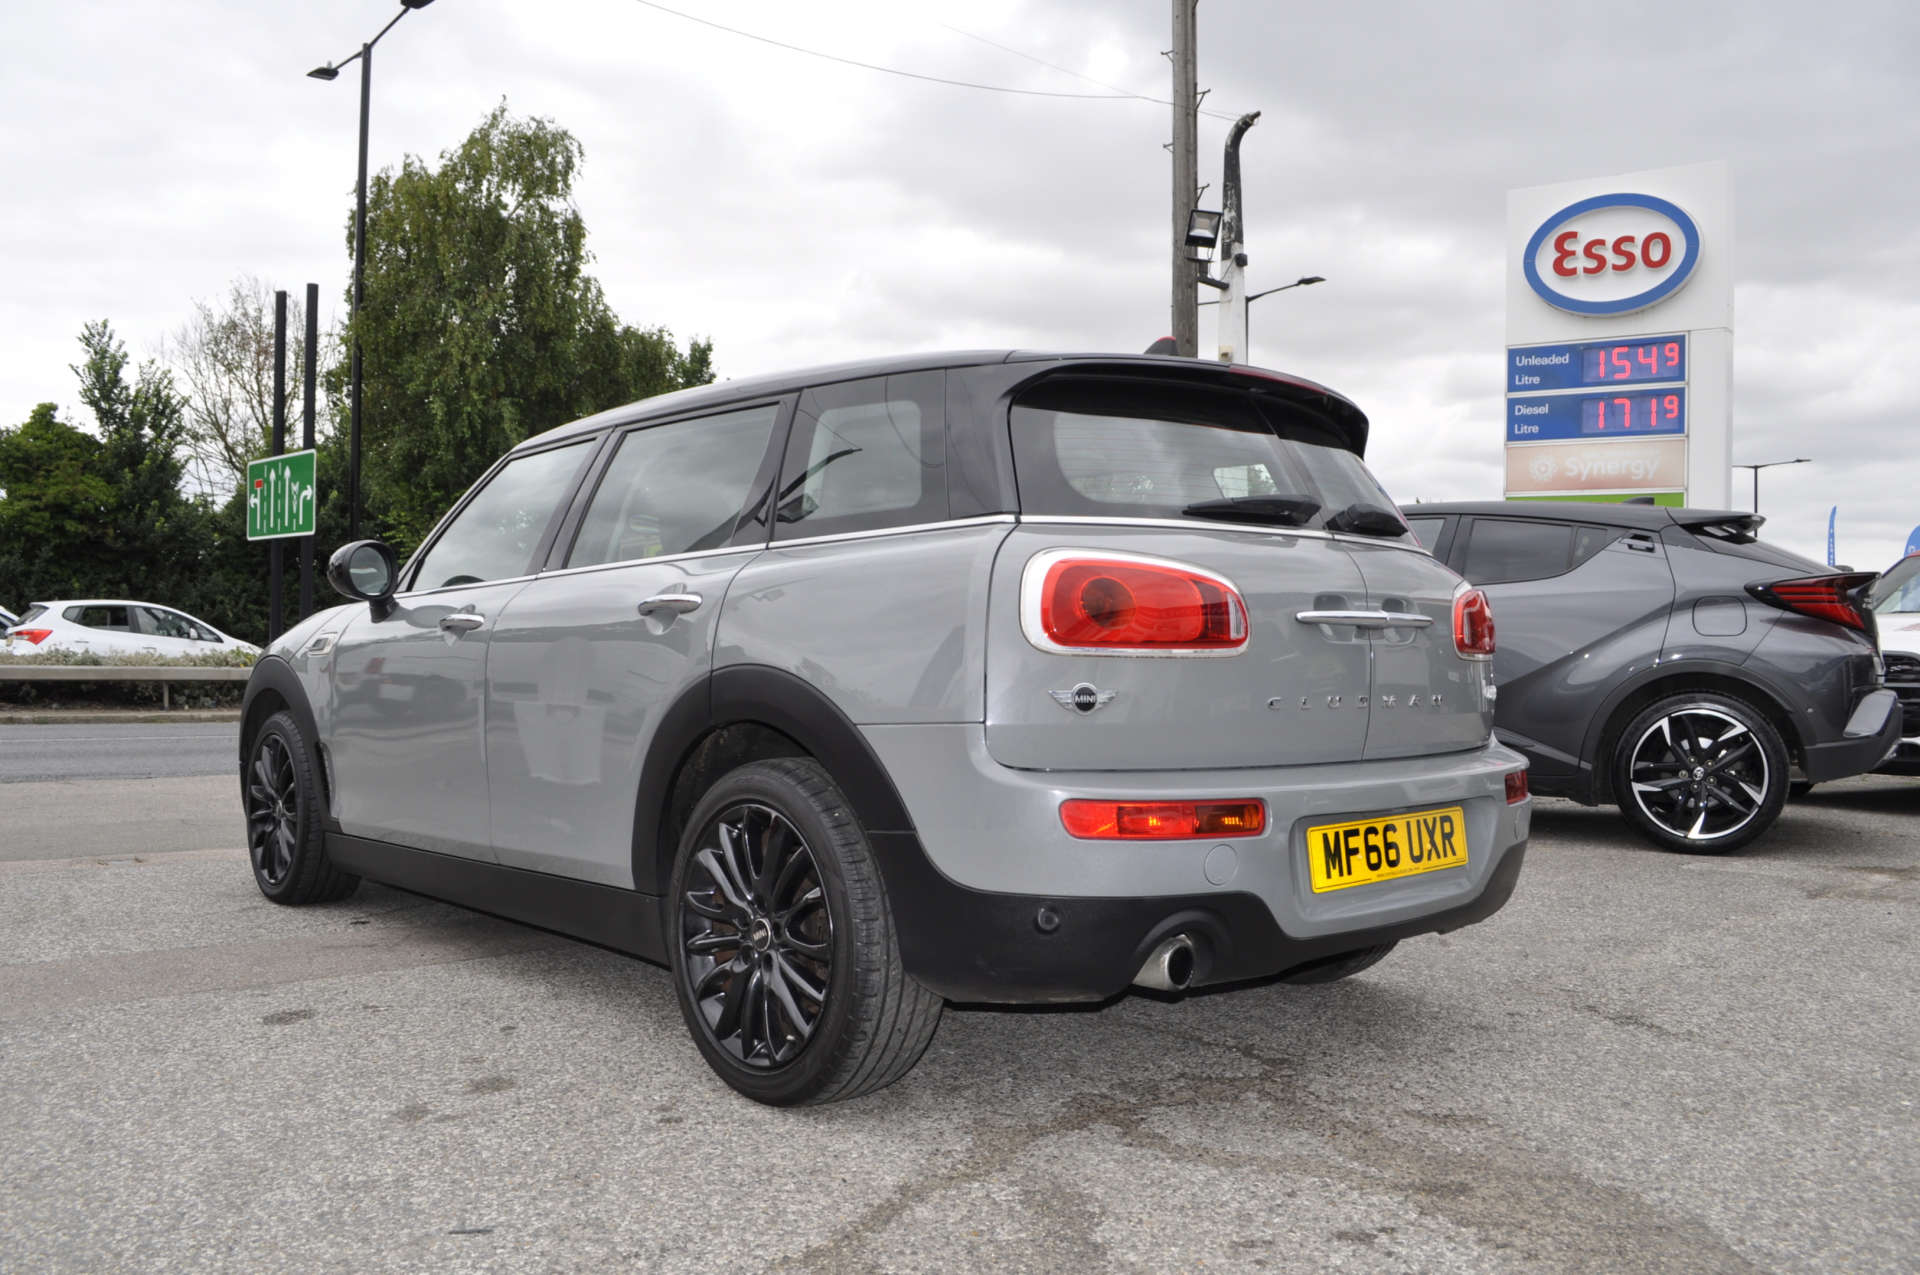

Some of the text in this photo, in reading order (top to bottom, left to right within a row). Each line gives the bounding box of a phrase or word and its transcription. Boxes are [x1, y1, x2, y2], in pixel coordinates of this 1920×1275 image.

[1552, 231, 1672, 277] Esso
[1515, 353, 1570, 367] Unleaded
[1515, 374, 1541, 385] Litre
[1514, 403, 1549, 416] Diesel
[1514, 423, 1540, 434] Litre
[1564, 453, 1662, 481] Synergy
[1074, 695, 1096, 704] MINI
[1322, 815, 1457, 879] MF66 UXR
